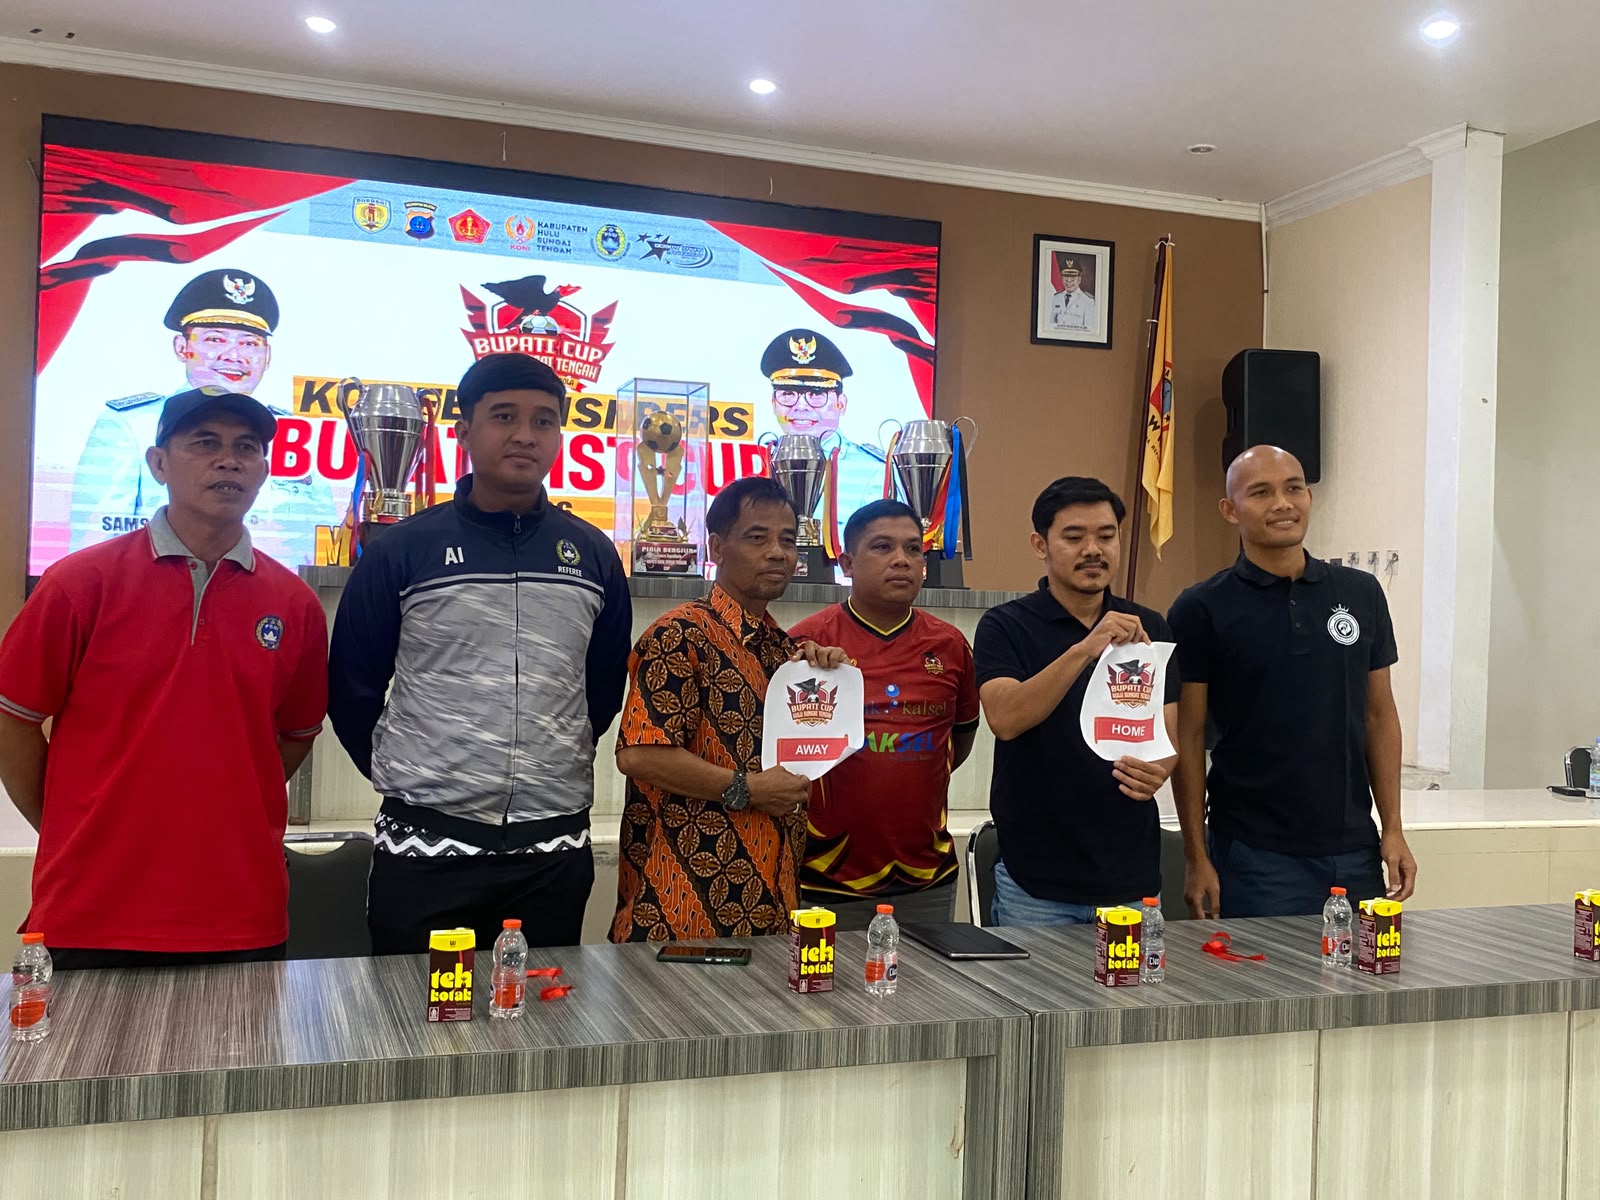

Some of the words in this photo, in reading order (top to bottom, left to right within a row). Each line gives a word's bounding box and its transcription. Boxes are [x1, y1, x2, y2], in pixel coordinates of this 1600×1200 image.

[537, 221, 588, 233] KABUPATEN
[537, 230, 560, 238] HULU
[510, 244, 531, 252] KONI
[536, 237, 572, 247] SUNGAI
[536, 244, 572, 255] TENGAH
[473, 336, 556, 354] BUPATI
[563, 341, 602, 363] CUP
[556, 358, 598, 379] TENGAH
[102, 516, 149, 531] SAMS
[445, 546, 464, 565] AI
[557, 565, 583, 577] REFEREE
[1111, 684, 1141, 693] BUPATI
[791, 703, 819, 713] BUPATI
[821, 704, 834, 713] CUP
[902, 700, 946, 716] kalsel
[1111, 723, 1146, 737] HOME
[795, 744, 829, 755] AWAY
[1377, 925, 1401, 947] teh
[801, 938, 834, 962] teh
[1108, 935, 1140, 958] teh
[1376, 946, 1400, 958] kotak
[801, 961, 833, 975] kotak
[1108, 958, 1139, 969] kotak
[431, 963, 472, 989] teh
[430, 989, 472, 1003] kotak
